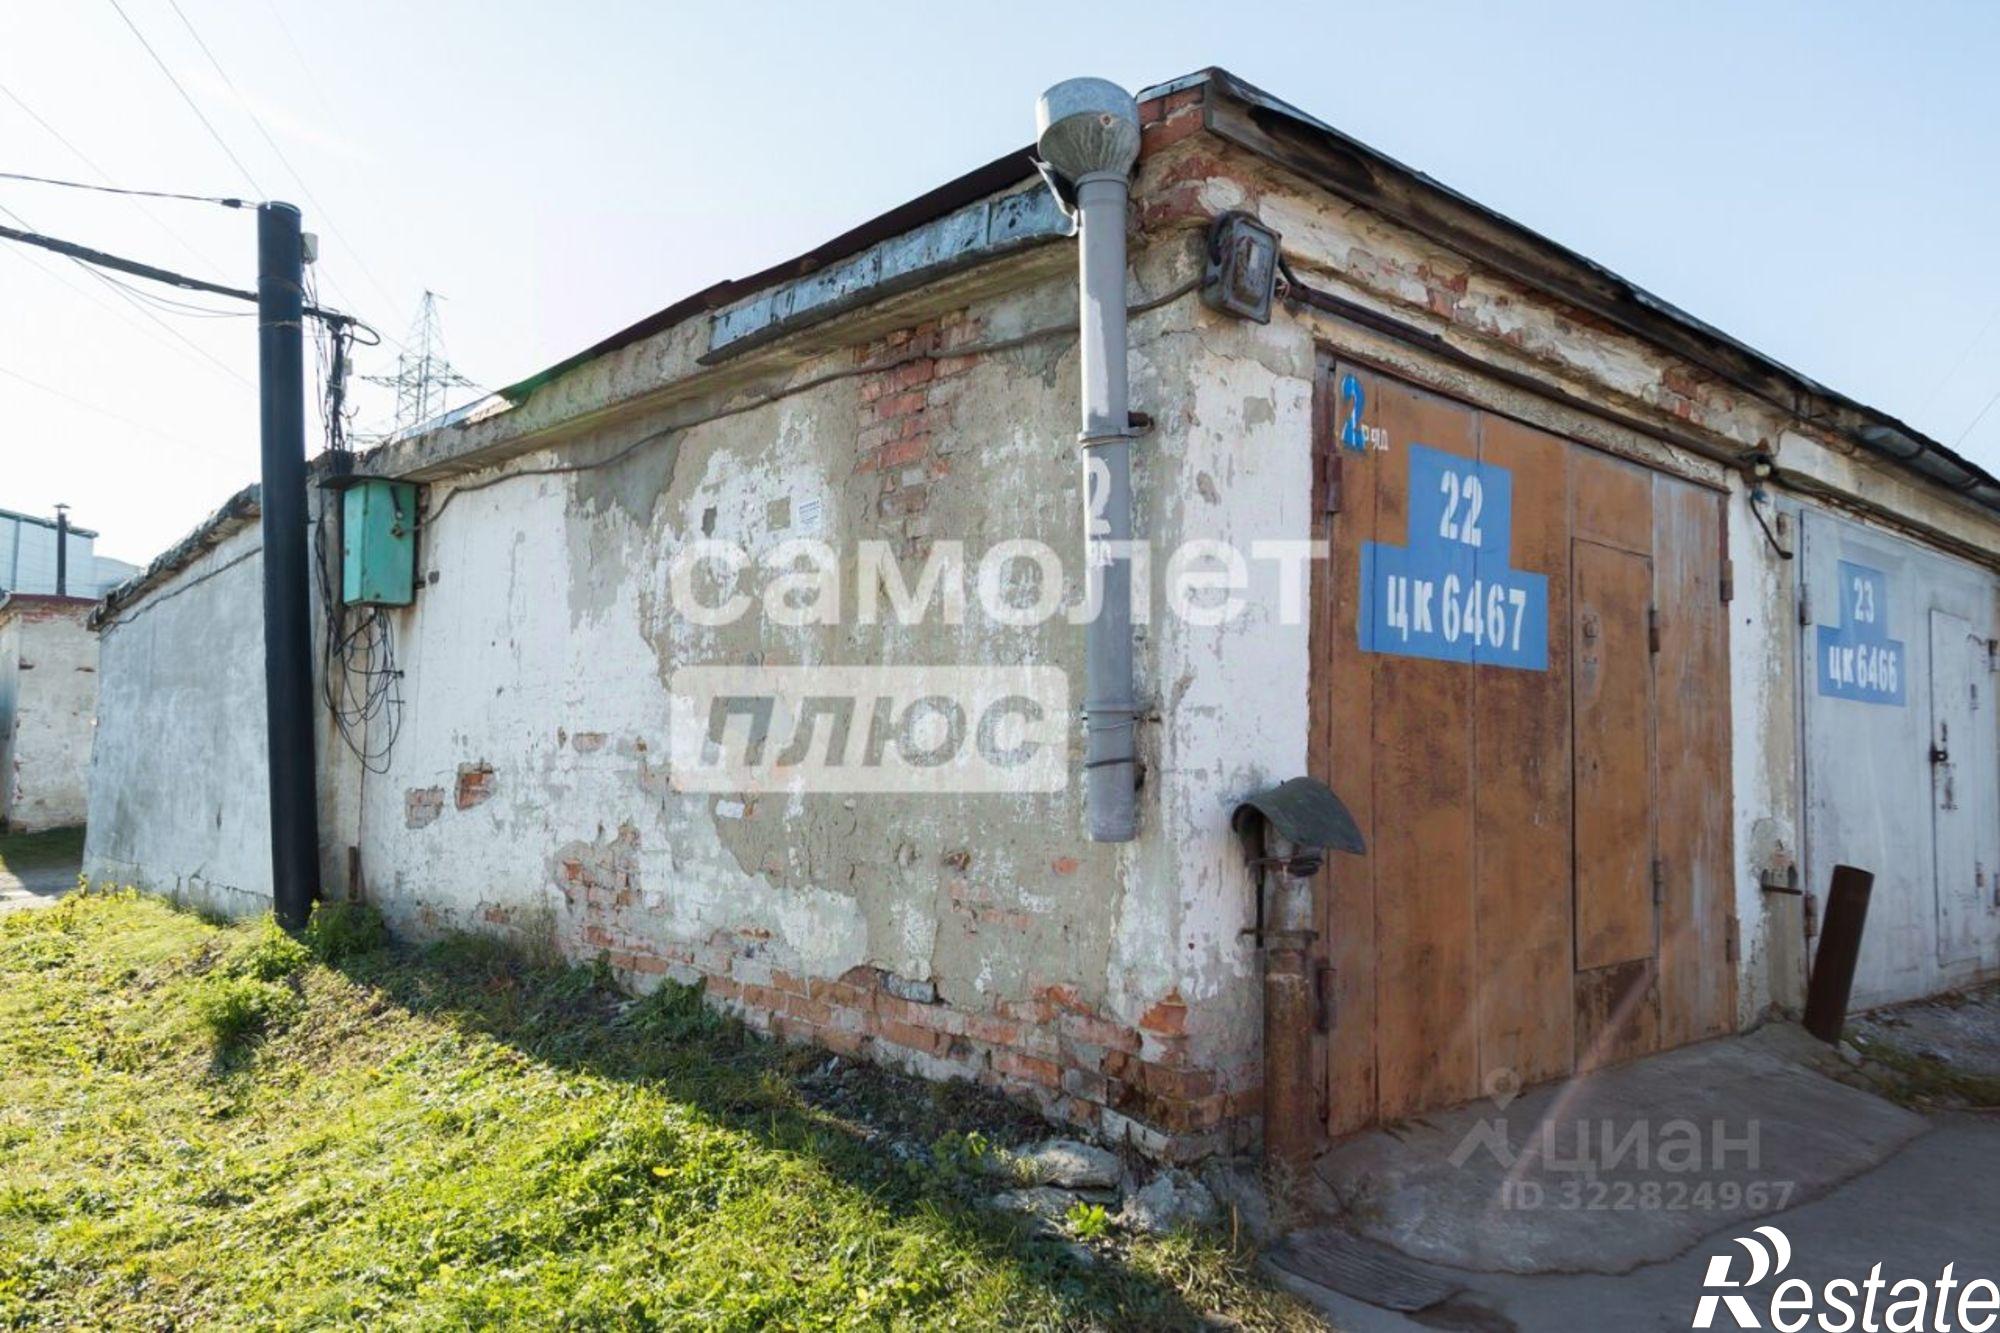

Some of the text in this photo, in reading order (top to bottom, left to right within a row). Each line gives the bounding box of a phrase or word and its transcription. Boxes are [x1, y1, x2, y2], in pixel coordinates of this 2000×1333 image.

[1341, 373, 1365, 452] 2
[1440, 470, 1484, 547] 22
[1853, 577, 1875, 624] 23
